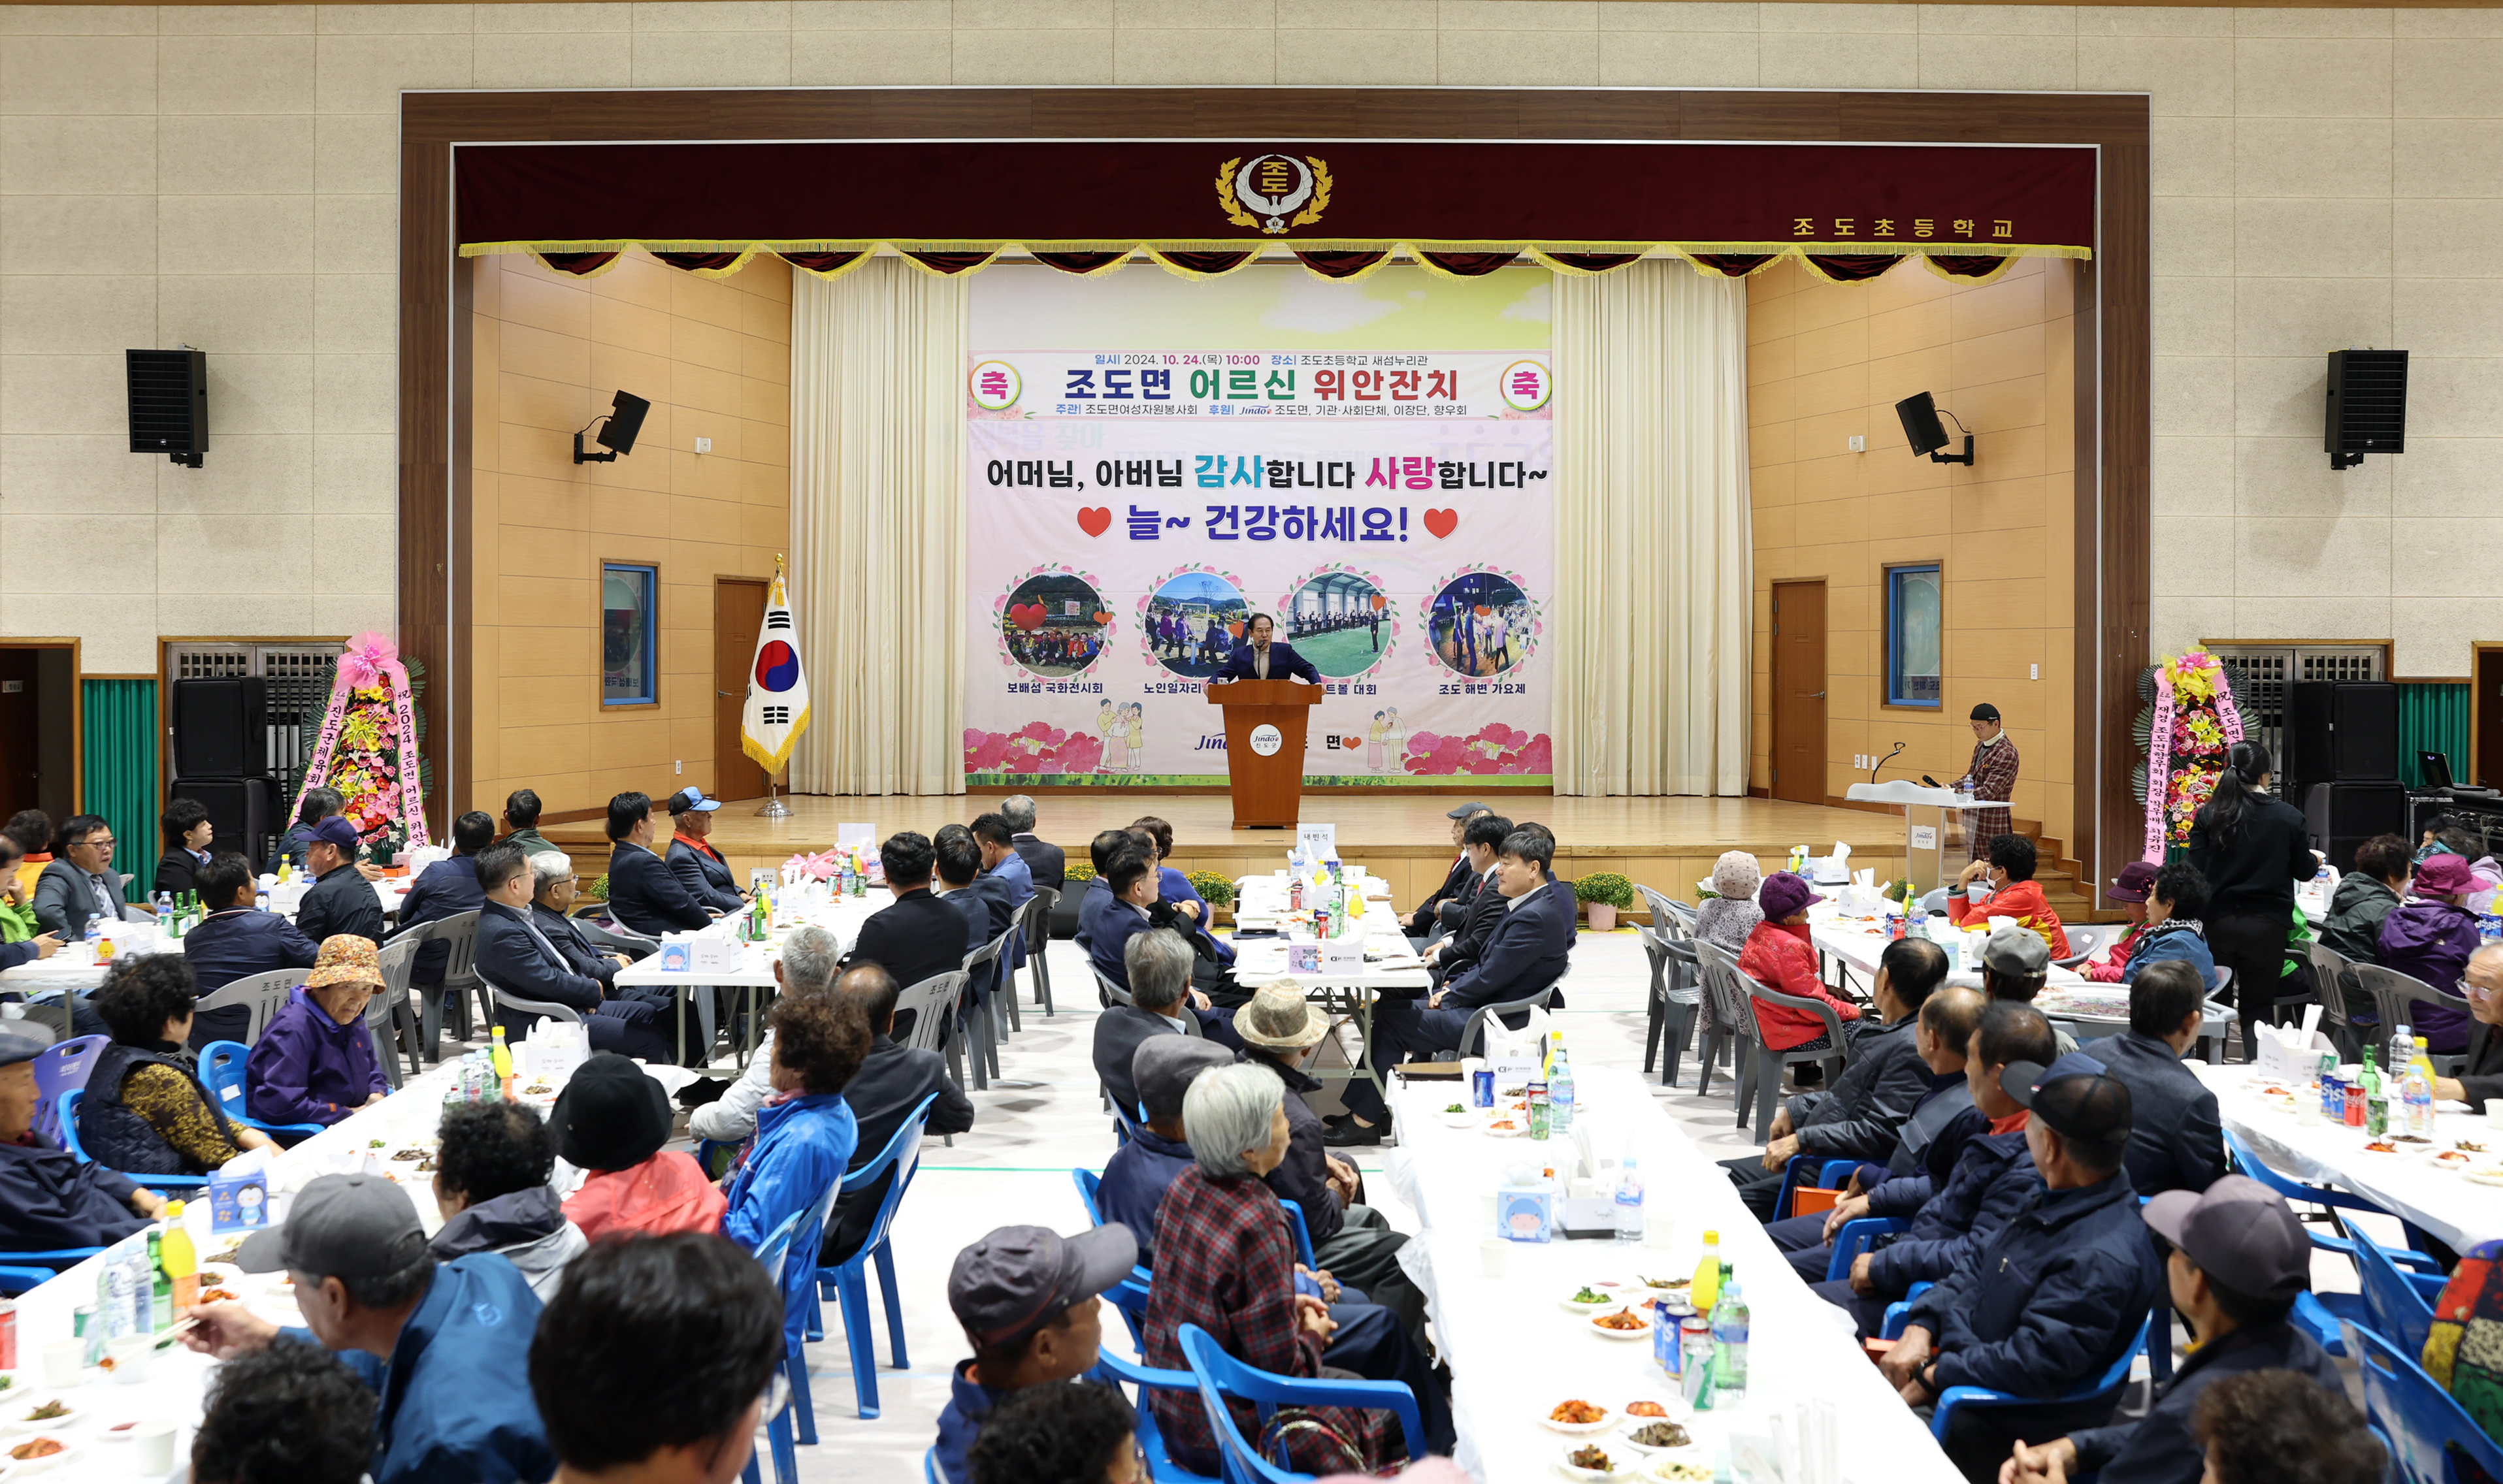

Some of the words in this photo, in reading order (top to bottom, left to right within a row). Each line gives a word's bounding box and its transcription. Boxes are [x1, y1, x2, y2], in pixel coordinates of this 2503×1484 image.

[1261, 161, 1288, 192] 조도
[1793, 218, 2012, 238] 조도초등학교
[1124, 354, 1158, 365] 2024.
[1162, 355, 1179, 365] 10.
[1226, 355, 1260, 365] 10:00
[1301, 355, 1367, 366] 조도초등학교
[1372, 355, 1428, 366] 새섬누리관
[980, 372, 1008, 399] 축
[1064, 369, 1171, 400] 조도면
[1190, 369, 1296, 400] 어르신
[1314, 369, 1457, 401] 위안잔치
[1512, 372, 1540, 400] 축
[1085, 404, 1197, 415] 조도면여성자원봉사회
[1239, 405, 1266, 415] Jindo
[1275, 405, 1311, 416] 조도면,
[1394, 405, 1430, 416] 이장단,
[1433, 405, 1467, 415] 향우회
[987, 459, 1085, 492] 어머님,
[1096, 459, 1183, 488] 아버님
[1194, 455, 1356, 489] 감사합니다
[1364, 456, 1548, 491] 사랑합니다~
[1126, 504, 1190, 540] 늘~
[1205, 505, 1409, 542] 건강하세요!
[397, 690, 411, 701] 祝
[1007, 682, 1041, 694] 보배섬
[1045, 682, 1103, 694] 국화전시회
[1143, 682, 1202, 694] 노인일자리
[1354, 684, 1377, 696] 대회
[1439, 684, 1461, 695] 조도
[1465, 683, 1488, 694] 해변
[1492, 683, 1526, 694] 가요제
[2216, 691, 2231, 703] 祝
[2156, 705, 2169, 723] 재경
[399, 704, 412, 744] 2024
[1253, 734, 1275, 743] Jindo
[402, 750, 416, 781] 조도면
[2151, 779, 2165, 796] 회장
[406, 785, 419, 816] 어르신
[1303, 833, 1328, 841] 내빈석
[261, 977, 292, 992] 조도면
